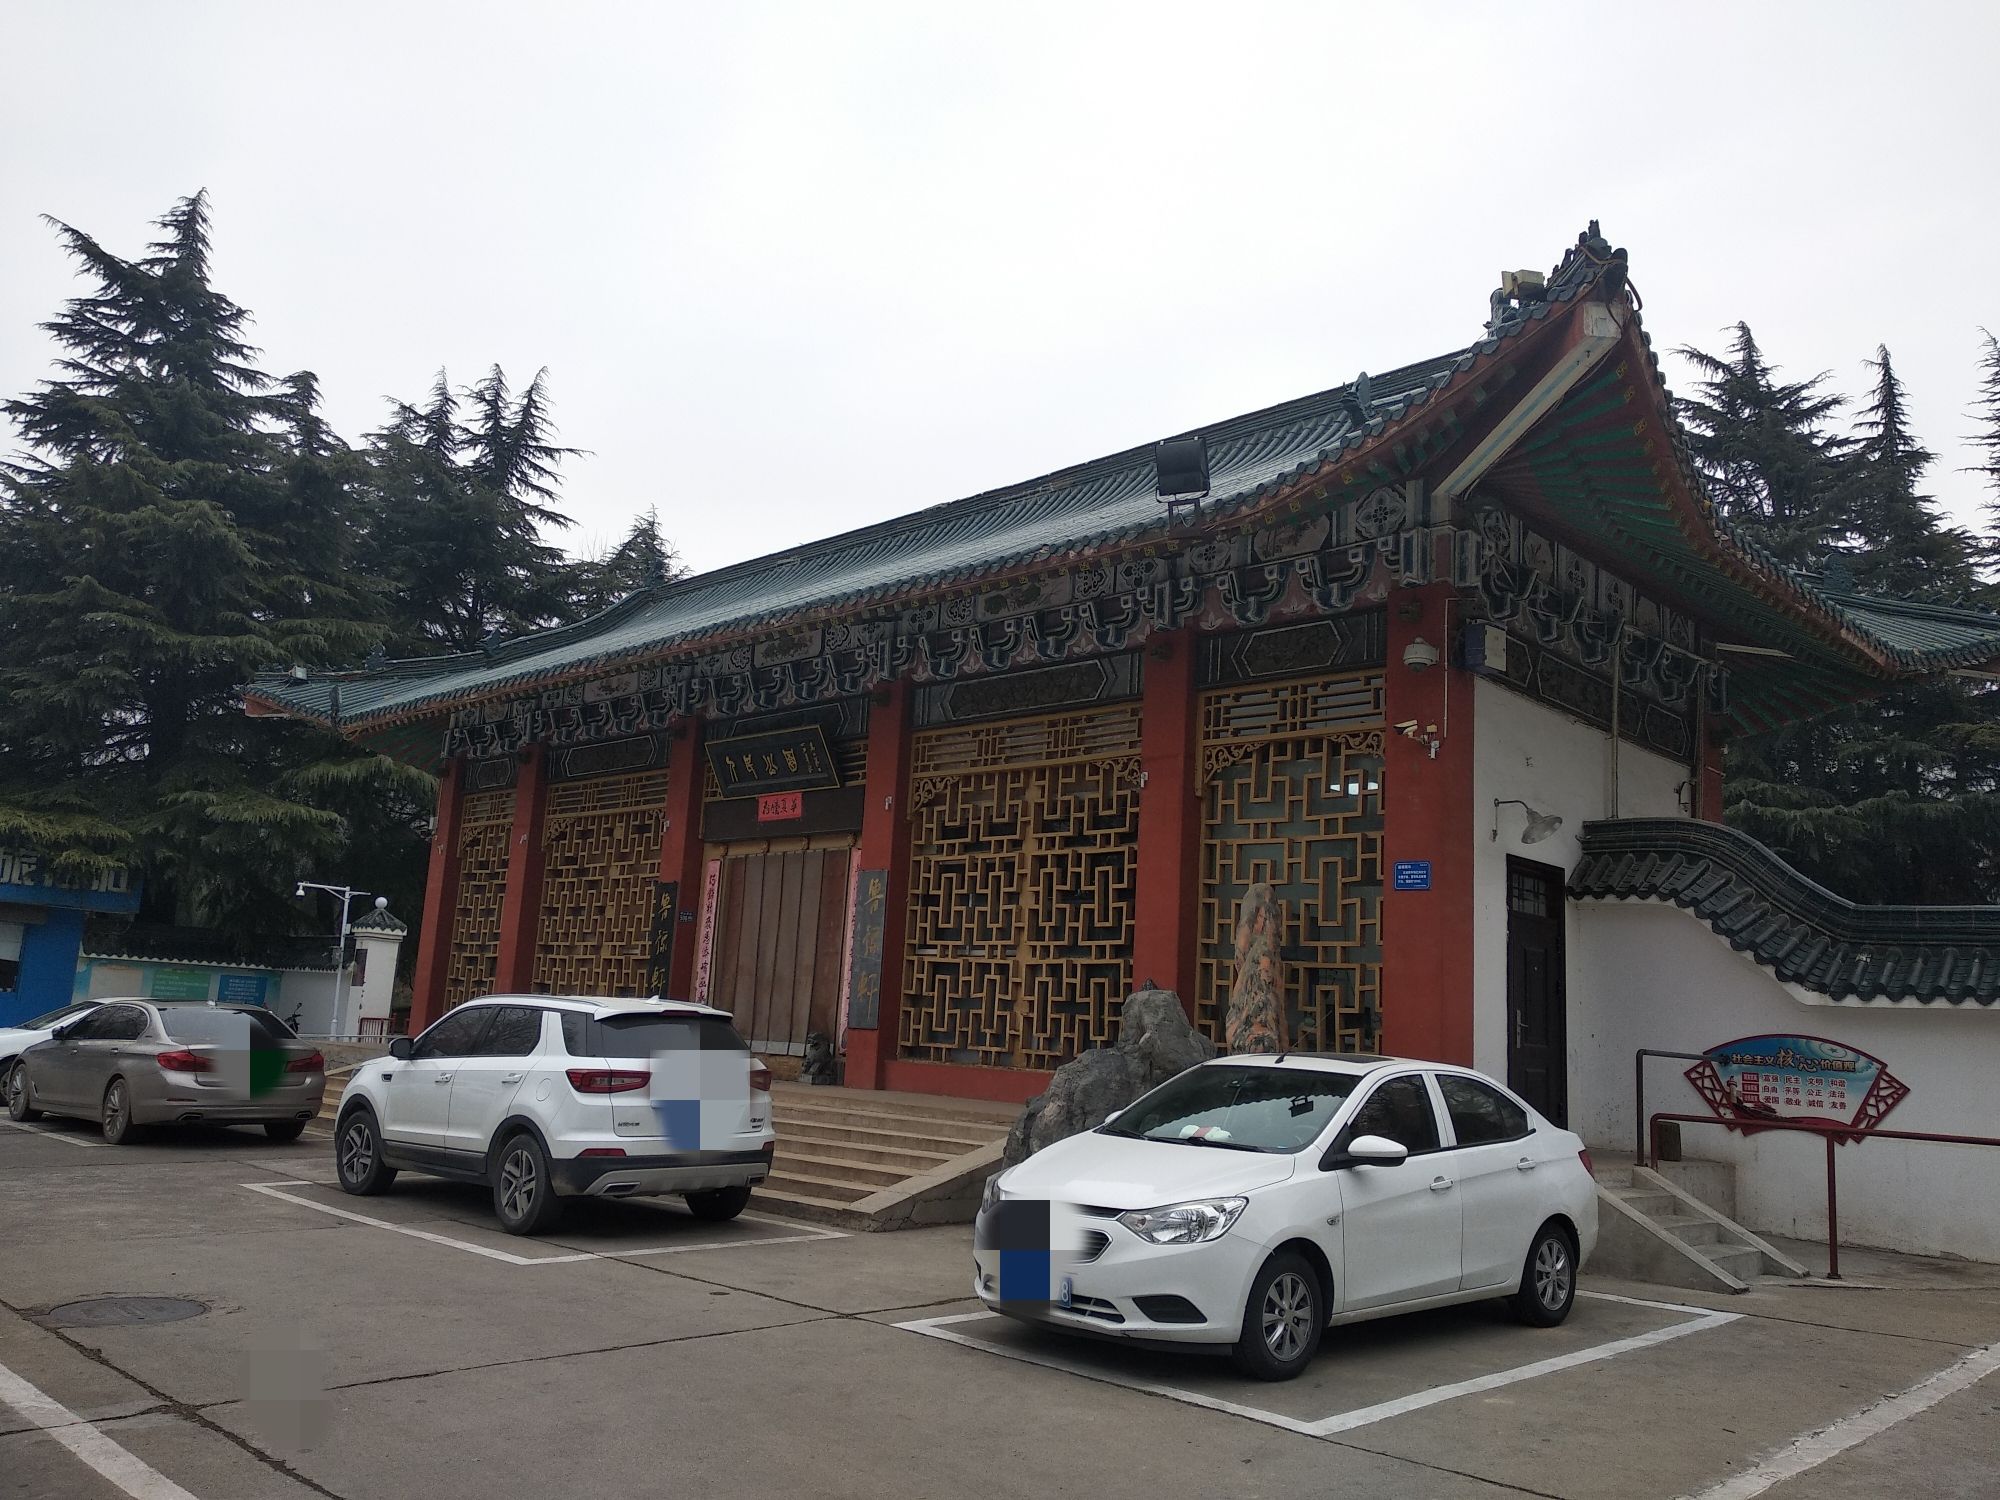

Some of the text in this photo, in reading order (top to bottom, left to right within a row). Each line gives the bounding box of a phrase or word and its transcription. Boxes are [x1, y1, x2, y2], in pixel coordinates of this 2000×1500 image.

[1731, 1048, 1856, 1072] 社会主义核心价值观
[1763, 1074, 1779, 1082] 富强
[1785, 1075, 1800, 1084] 民主
[1808, 1077, 1824, 1086] 文明
[1829, 1079, 1846, 1088] 和谐
[1762, 1085, 1778, 1094] 自由
[1785, 1087, 1800, 1096] 平等
[1807, 1089, 1822, 1097] 公正
[1829, 1090, 1845, 1099] 法治
[1763, 1096, 1779, 1105] 爱国
[1785, 1097, 1801, 1106] 敬业
[1807, 1100, 1824, 1108] 诚信
[1829, 1101, 1847, 1110] 友善
